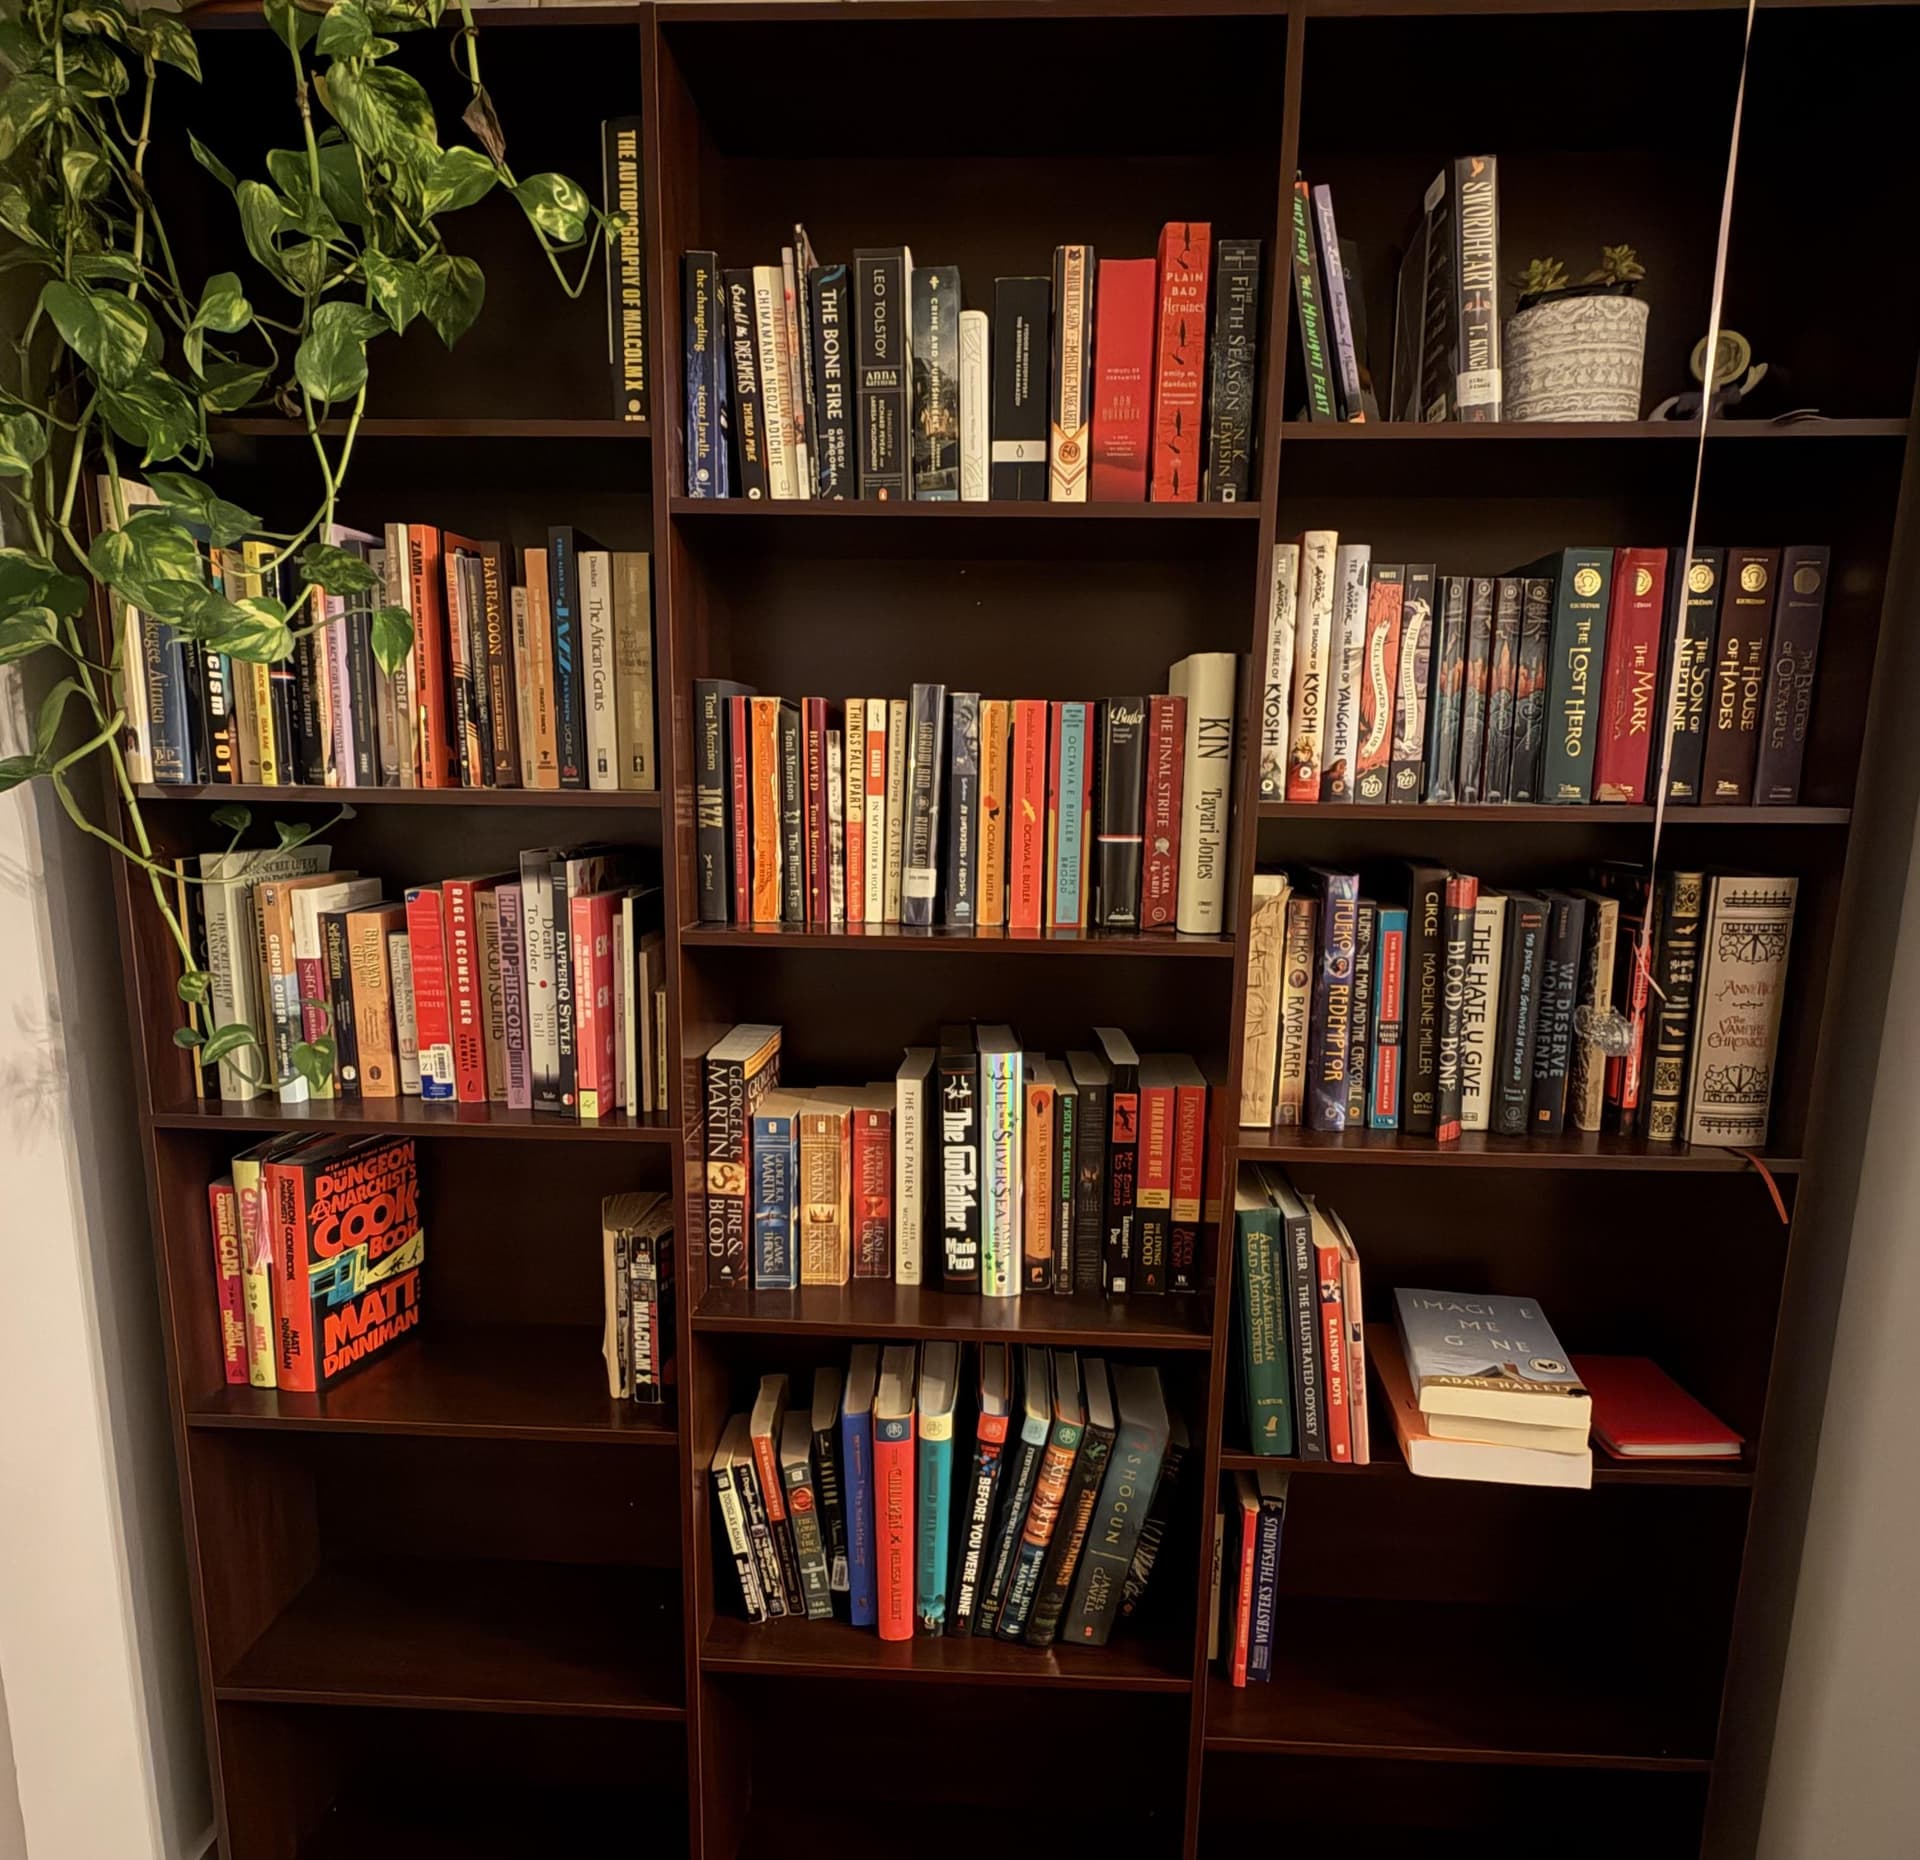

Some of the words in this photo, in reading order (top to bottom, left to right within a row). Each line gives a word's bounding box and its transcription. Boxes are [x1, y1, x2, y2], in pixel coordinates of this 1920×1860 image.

[1462, 181, 1493, 292] SWORDHEART
[696, 269, 708, 287] the
[873, 269, 887, 297] LEO
[1166, 272, 1204, 282] PLAIN
[1171, 287, 1197, 297] BAD
[693, 290, 709, 353] changeling
[821, 288, 839, 325] THE
[930, 297, 939, 332] CRIME
[1230, 276, 1249, 329] FIFTH
[873, 301, 887, 359] TOLSTOY
[930, 336, 939, 358] AND
[823, 328, 842, 380] BONE
[1225, 334, 1245, 411] SEASON
[826, 383, 843, 420] FIRE
[930, 361, 939, 428] PUNISHMENT
[1218, 416, 1236, 478] JEMISIN
[589, 556, 599, 588] Davidson
[483, 556, 502, 657] BARRACOON
[589, 598, 603, 622] The
[330, 637, 340, 663] BLACK
[590, 626, 606, 669] African
[1575, 618, 1592, 644] THE
[1694, 637, 1710, 664] THE
[1726, 638, 1739, 659] OF
[1748, 638, 1763, 664] THE
[1567, 647, 1592, 696] LOST
[1633, 642, 1649, 668] THE
[331, 666, 340, 691] GIRLS
[592, 669, 608, 712] Genius
[1689, 664, 1710, 709] SON
[1717, 660, 1740, 731] HADES
[1740, 665, 1762, 732] HOUSE
[704, 693, 717, 720] Toni
[1161, 703, 1175, 732] THE
[1629, 670, 1655, 737] MARK
[1688, 715, 1701, 734] OF
[334, 712, 345, 755] ACTIVISTS
[705, 722, 719, 771] Morrison
[784, 728, 796, 752] Toni
[849, 706, 862, 746] THINGS
[1197, 717, 1231, 760] KIN
[1563, 700, 1586, 758] HERO
[213, 729, 233, 774] 101
[808, 730, 820, 792] BELOVED
[849, 748, 862, 774] FALL
[916, 721, 934, 789] SORROWLAND
[1159, 736, 1173, 779] FINAL
[785, 755, 797, 801] Morrison
[849, 776, 862, 811] APART
[697, 785, 724, 829] JAZZ
[735, 802, 745, 825] Toni
[810, 803, 819, 826] Toni
[1156, 782, 1171, 828] STRIFE
[1196, 788, 1223, 834] Tayari
[735, 828, 746, 875] Morrison
[810, 828, 820, 875] Morrison
[890, 818, 900, 879] GAINES
[1197, 837, 1220, 880] Jones
[1059, 856, 1068, 894] BROOD
[1150, 860, 1161, 899] EL-ARIFI
[1161, 864, 1170, 896] SAARA
[451, 888, 466, 923] RAGE
[527, 903, 539, 925] To
[850, 878, 860, 917] Achebe
[1423, 891, 1439, 937] CIRCE
[1332, 899, 1354, 951] IFUEKO
[1472, 925, 1492, 965] THE
[268, 934, 285, 982] GENDER
[454, 929, 470, 993] BECOMES
[528, 929, 540, 973] Order
[556, 931, 571, 1001] DAPPERQ
[1356, 952, 1370, 972] THE
[1354, 973, 1369, 1001] MAID
[1420, 952, 1437, 1026] MADELINE
[1468, 972, 1489, 1024] HATE
[1556, 962, 1576, 990] WE
[273, 983, 288, 1025] QUEER
[461, 1000, 472, 1025] HER
[533, 1012, 544, 1038] Ball
[1353, 1001, 1368, 1024] AND
[1533, 959, 1558, 1079] MONUMENTS
[559, 1004, 572, 1055] STYLE
[1283, 995, 1305, 1079] RAYBEARER
[1323, 984, 1349, 1081] REDEMPTOR
[1352, 1024, 1367, 1043] THE
[1468, 1030, 1486, 1044] U
[1549, 999, 1573, 1077] DESERVE
[459, 1033, 470, 1073] CHEMALY
[468, 1037, 478, 1070] SORAYA
[1348, 1046, 1365, 1101] CROCODILE
[1418, 1028, 1434, 1076] MILLER
[1463, 1050, 1483, 1098] GIVE
[708, 1064, 728, 1158] MARTIN
[904, 1091, 914, 1112] THE
[904, 1115, 914, 1153] SILENT
[943, 1107, 972, 1142] The
[1181, 1095, 1200, 1163] TANANARIVE
[315, 1140, 415, 1201] DUNGEON
[762, 1152, 775, 1204] MARTIN
[775, 1152, 785, 1178] GEORGE
[862, 1144, 875, 1195] MARTIN
[903, 1156, 914, 1200] PATIENT
[1123, 1152, 1134, 1167] My
[1181, 1166, 1196, 1193] DUE
[943, 1145, 977, 1232] Godfather
[314, 1178, 418, 1258] COOK
[369, 1217, 418, 1260] BOOK
[708, 1198, 725, 1257] BLOOD
[875, 1225, 885, 1251] FEAST
[1120, 1214, 1134, 1259] Tananarive
[219, 1234, 240, 1281] CARL
[285, 1226, 296, 1281] COOKBOOK
[774, 1236, 783, 1265] GAME
[945, 1238, 977, 1255] Mario
[1142, 1222, 1155, 1266] BLOOD
[1294, 1226, 1308, 1271] HOMER
[1247, 1231, 1264, 1317] READ-ALOUD
[1258, 1231, 1277, 1361] AFRICAN-AMERICAN
[1298, 1283, 1310, 1309] THE
[234, 1321, 245, 1348] MATT
[323, 1268, 419, 1358] MATT
[1458, 1320, 1501, 1333] ME
[223, 1309, 237, 1362] DINNIMAN
[281, 1317, 292, 1370] DINNIMAN
[291, 1330, 301, 1356] MATT
[323, 1305, 419, 1379] DINNIMAN
[633, 1301, 652, 1371] MALCOLM
[1250, 1318, 1266, 1366] STORIES
[1298, 1310, 1315, 1385] ILLUSTRATED
[1328, 1317, 1342, 1372] RAINBOW
[635, 1372, 652, 1385] X
[1332, 1377, 1343, 1406] BOYS
[1303, 1386, 1318, 1437] ODYSSEY
[1047, 1450, 1070, 1488] EXIT
[973, 1476, 992, 1523] BEFORE
[1033, 1491, 1058, 1539] PARTY
[1103, 1453, 1141, 1544] SHŌGUN
[967, 1523, 986, 1549] YOU
[1259, 1516, 1279, 1583] THESAURUS
[961, 1550, 980, 1583] WERE
[1009, 1562, 1031, 1604] MANDEL
[957, 1583, 976, 1616] ANNE
[1082, 1565, 1105, 1615] CLAVELL
[1094, 1573, 1112, 1612] JAMES
[1254, 1586, 1273, 1643] WEBSTER'S
